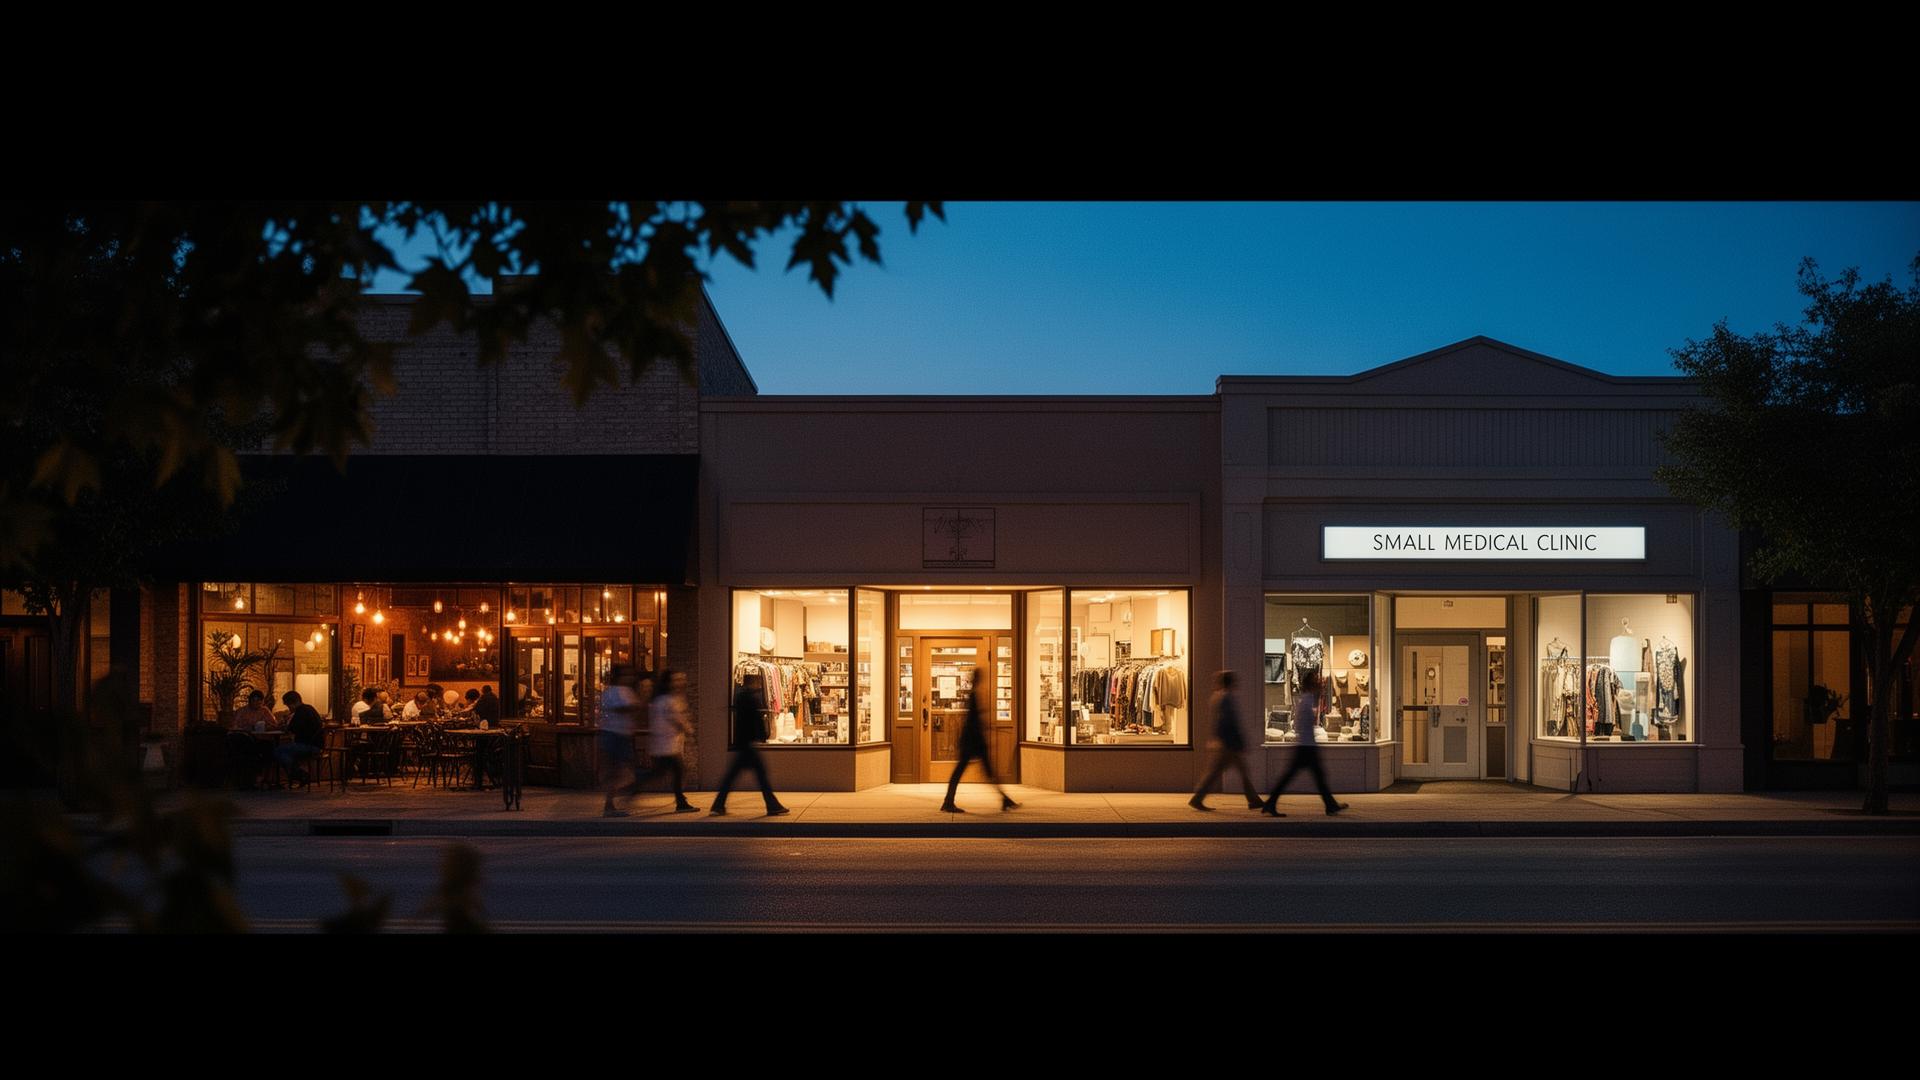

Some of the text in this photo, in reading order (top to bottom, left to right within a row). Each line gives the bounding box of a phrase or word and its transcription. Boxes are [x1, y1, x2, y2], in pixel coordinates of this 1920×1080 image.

[1373, 533, 1597, 551] SMALL MEDICAL CLINIC
